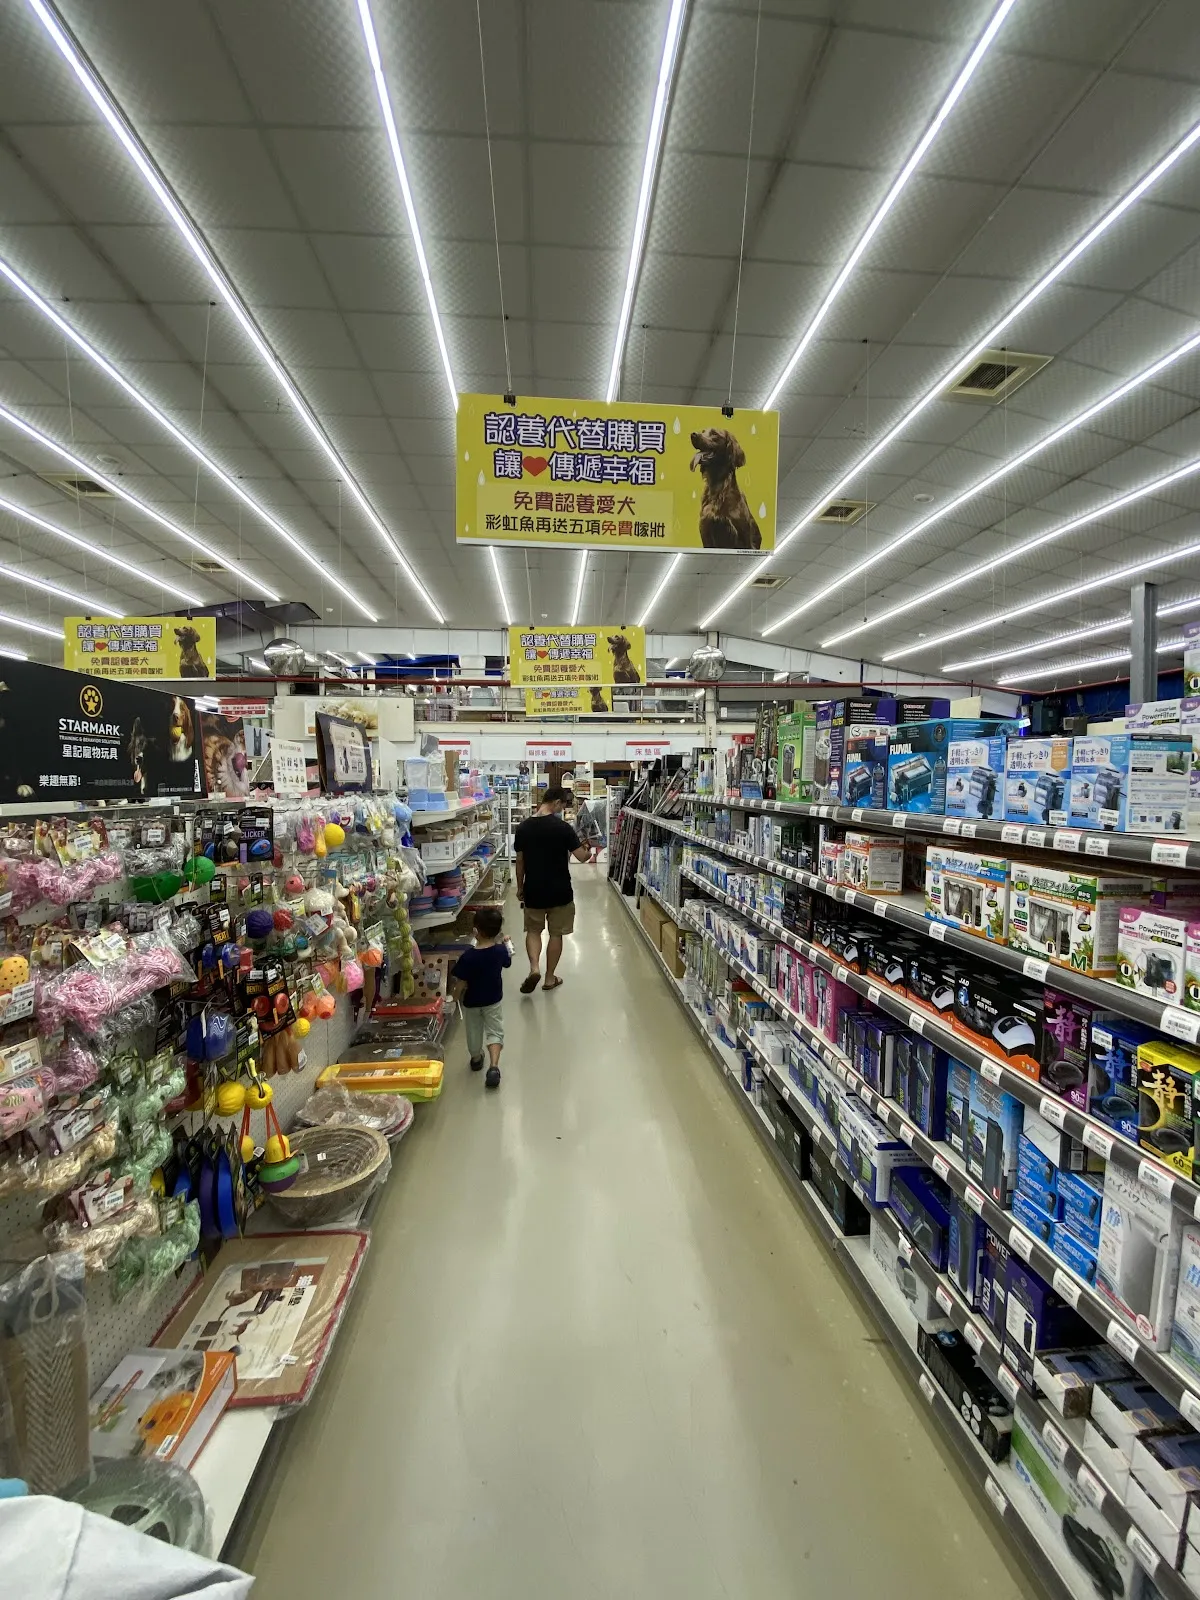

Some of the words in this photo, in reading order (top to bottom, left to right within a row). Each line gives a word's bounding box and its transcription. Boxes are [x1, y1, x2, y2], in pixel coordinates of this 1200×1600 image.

[484, 412, 666, 454] 認養代替購買
[493, 449, 523, 479] 讓
[547, 453, 656, 485] 傳遞幸福
[513, 490, 636, 515] 免費認養愛犬
[77, 624, 162, 639] 認養代替購買
[58, 718, 121, 736] STARMARK
[62, 744, 118, 760] 星記寵物玩具
[985, 924, 995, 939] L
[1153, 922, 1180, 932] Aquarium
[1070, 952, 1088, 972] M
